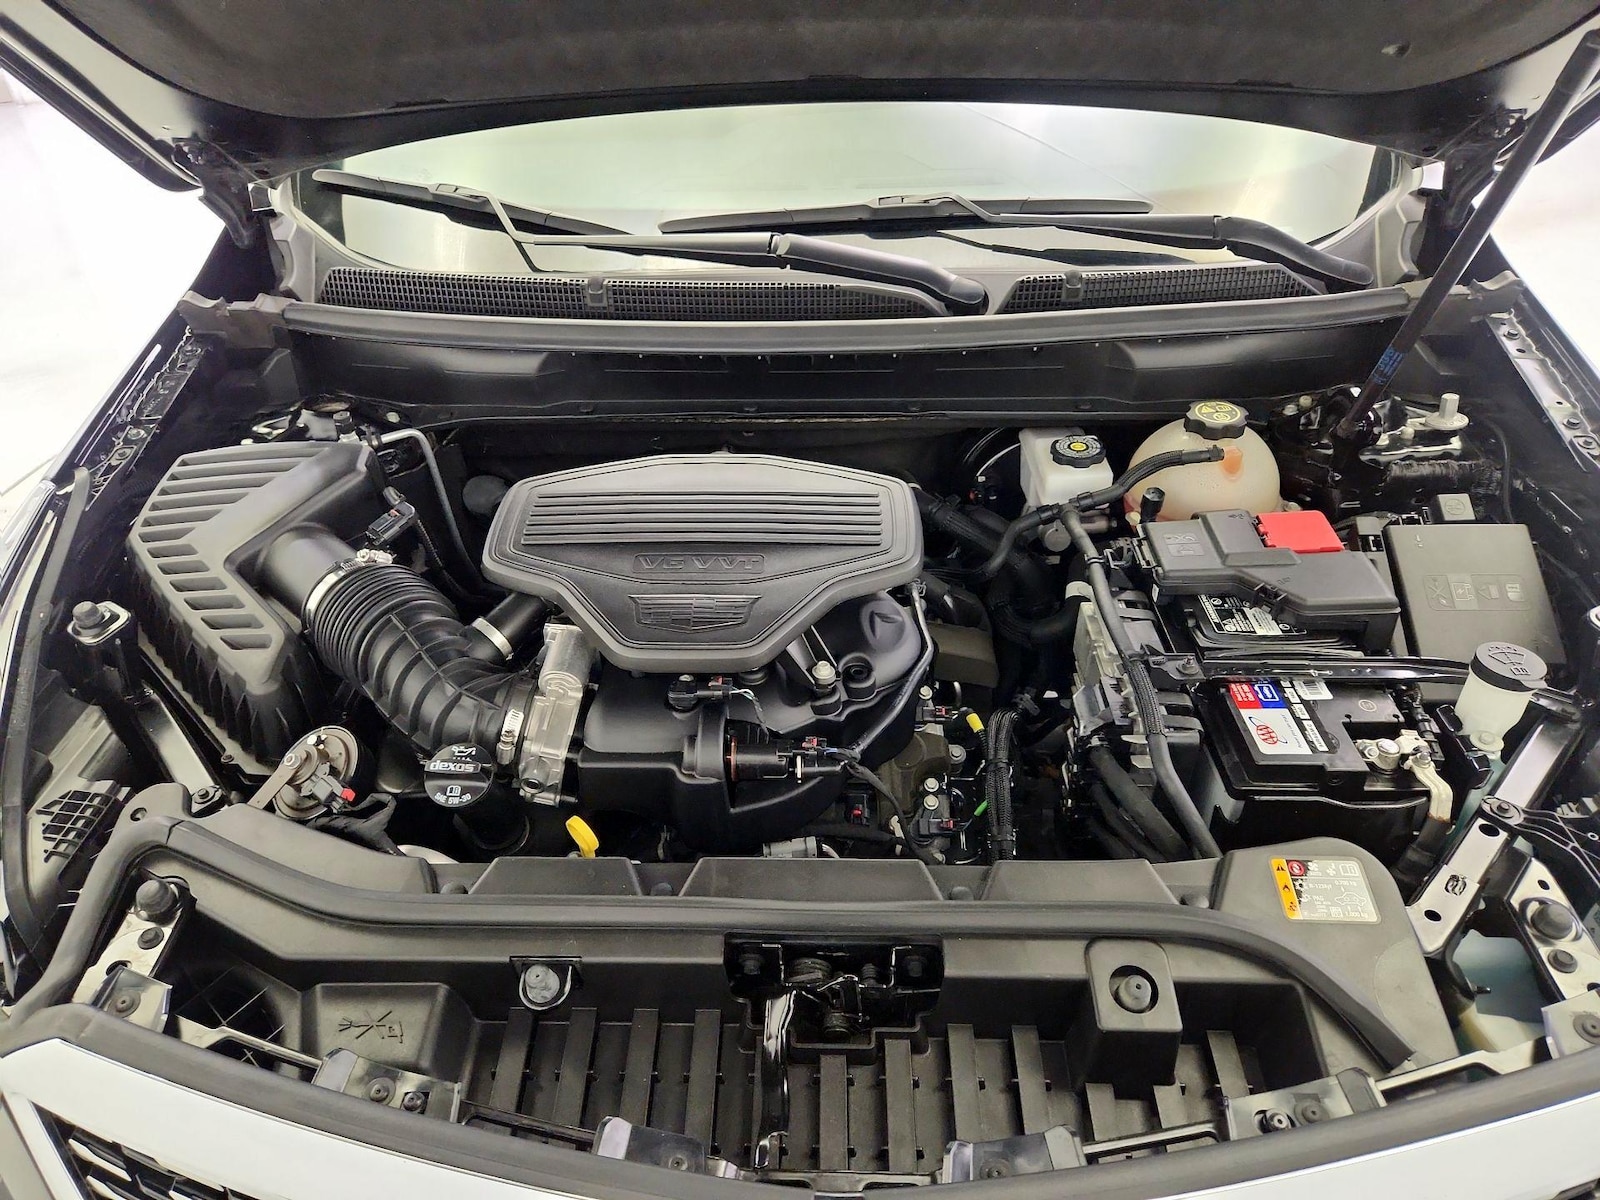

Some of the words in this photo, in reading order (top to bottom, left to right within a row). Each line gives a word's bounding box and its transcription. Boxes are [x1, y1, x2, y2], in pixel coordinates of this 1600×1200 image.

[639, 556, 685, 570] V6
[691, 556, 761, 570] VVT
[1256, 725, 1278, 745] AAA
[430, 760, 476, 772] dexos
[434, 792, 448, 803] SAE
[447, 793, 472, 804] 5W-30
